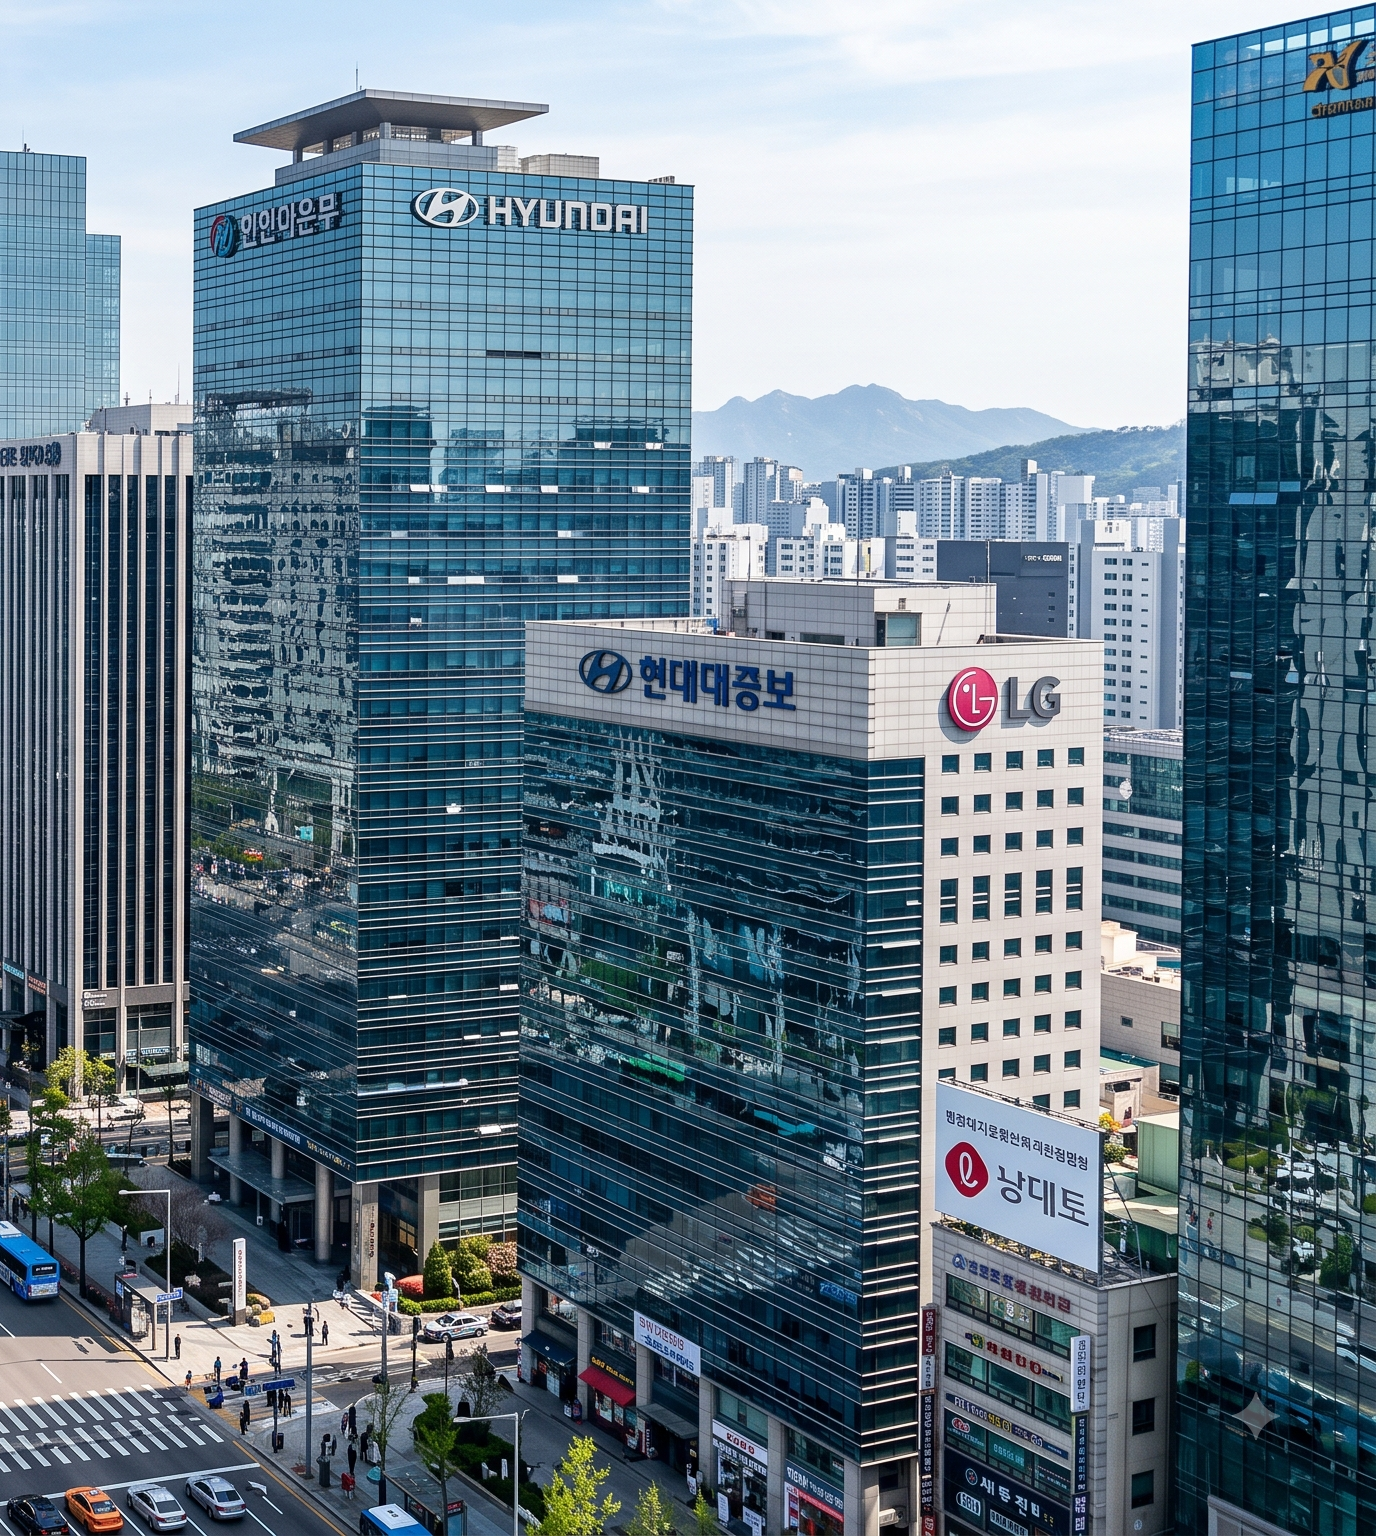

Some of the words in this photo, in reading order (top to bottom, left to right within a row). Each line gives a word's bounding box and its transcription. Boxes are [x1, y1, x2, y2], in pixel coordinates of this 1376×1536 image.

[488, 195, 648, 234] HYUNDAI
[639, 655, 797, 712] 현대대증보
[1007, 675, 1061, 720] LG
